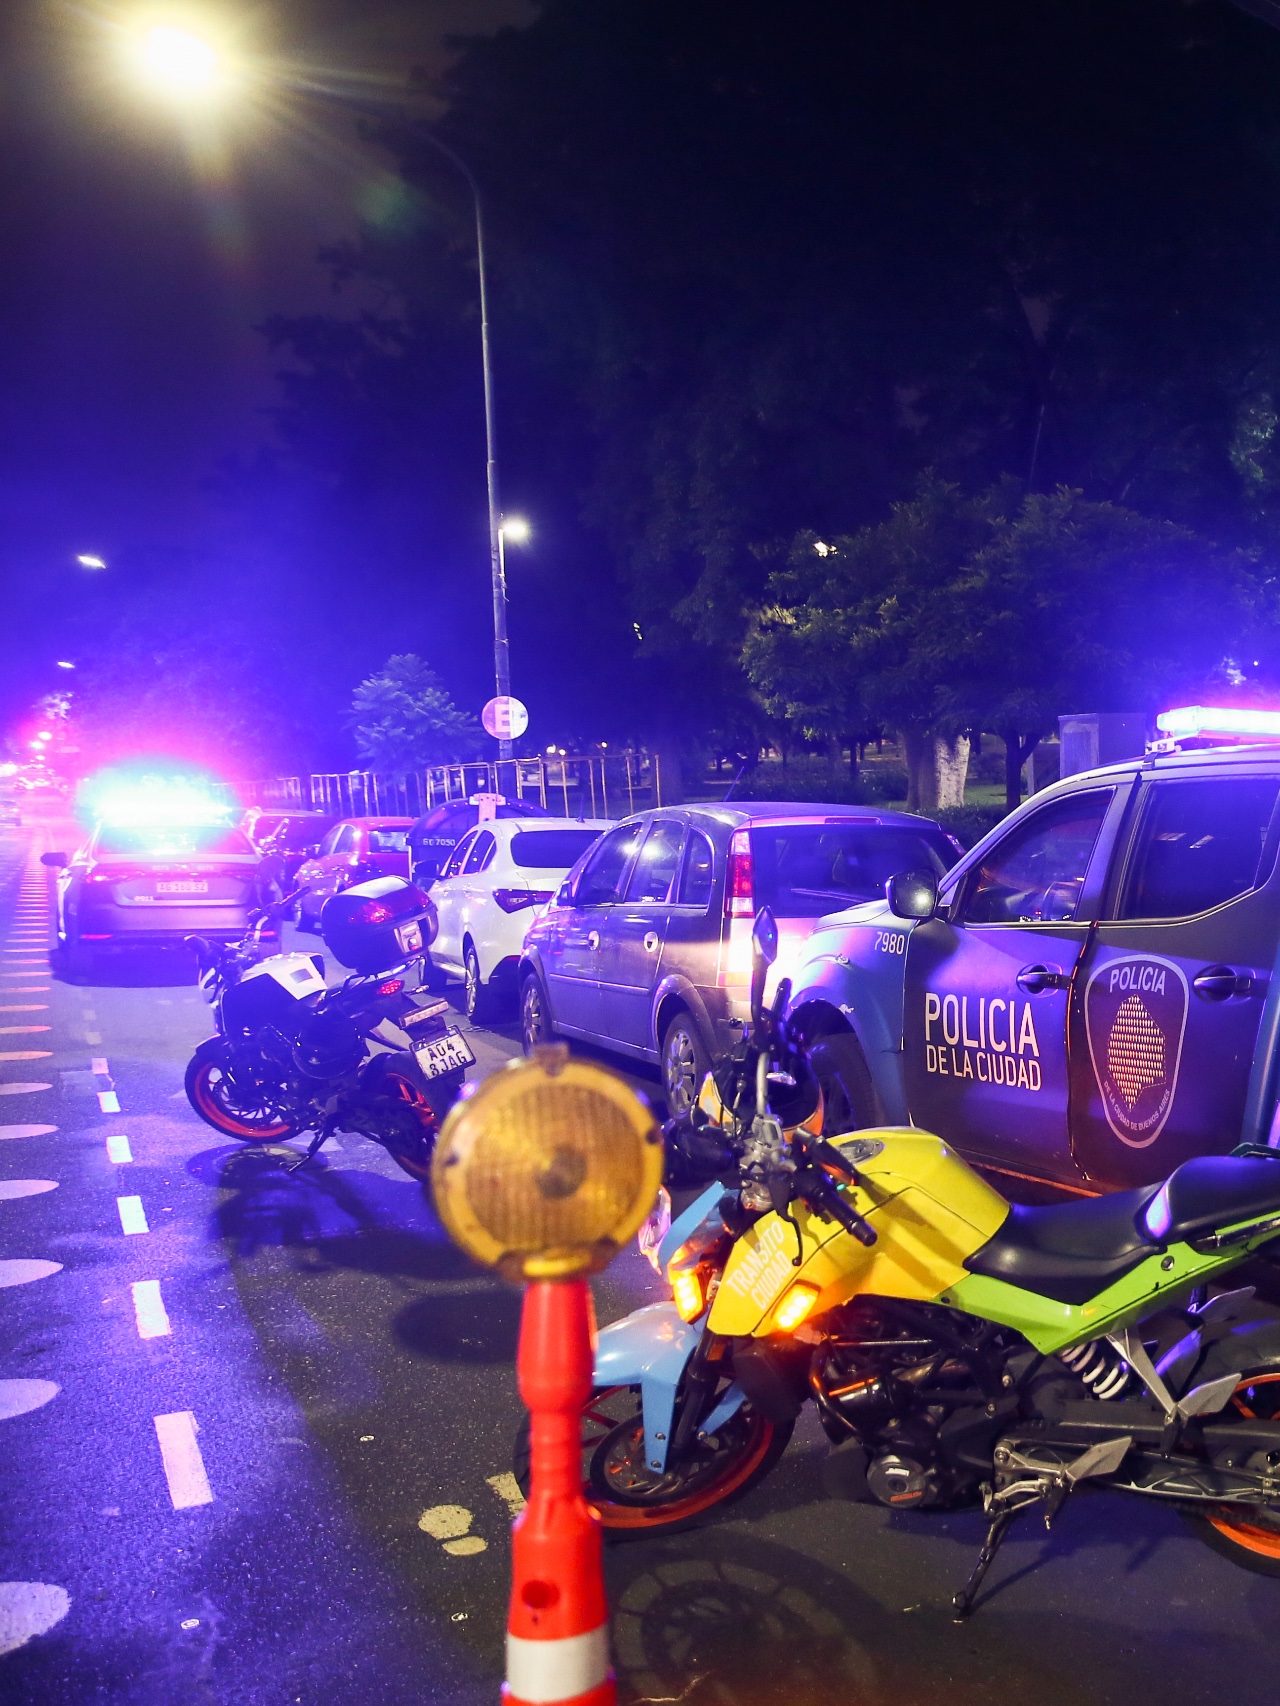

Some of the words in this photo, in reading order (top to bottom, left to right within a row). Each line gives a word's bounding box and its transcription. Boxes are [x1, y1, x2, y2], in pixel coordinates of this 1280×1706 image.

[874, 931, 905, 955] 7980
[1109, 966, 1166, 996] POLICIA
[925, 992, 1040, 1057] POLICIA
[429, 1050, 468, 1077] 8JAG
[926, 1044, 949, 1075] DE
[951, 1047, 974, 1079] LA
[976, 1051, 1042, 1092] CIUDAD
[1103, 1080, 1112, 1094] DE
[1109, 1093, 1116, 1106] LA
[1114, 1104, 1130, 1128] CIUDAD
[1130, 1121, 1138, 1131] DE
[1138, 1110, 1159, 1131] BUENOS
[1158, 1088, 1171, 1114] AIRES
[726, 1220, 785, 1298] TRANSITO
[750, 1249, 793, 1310] CIUDAD
